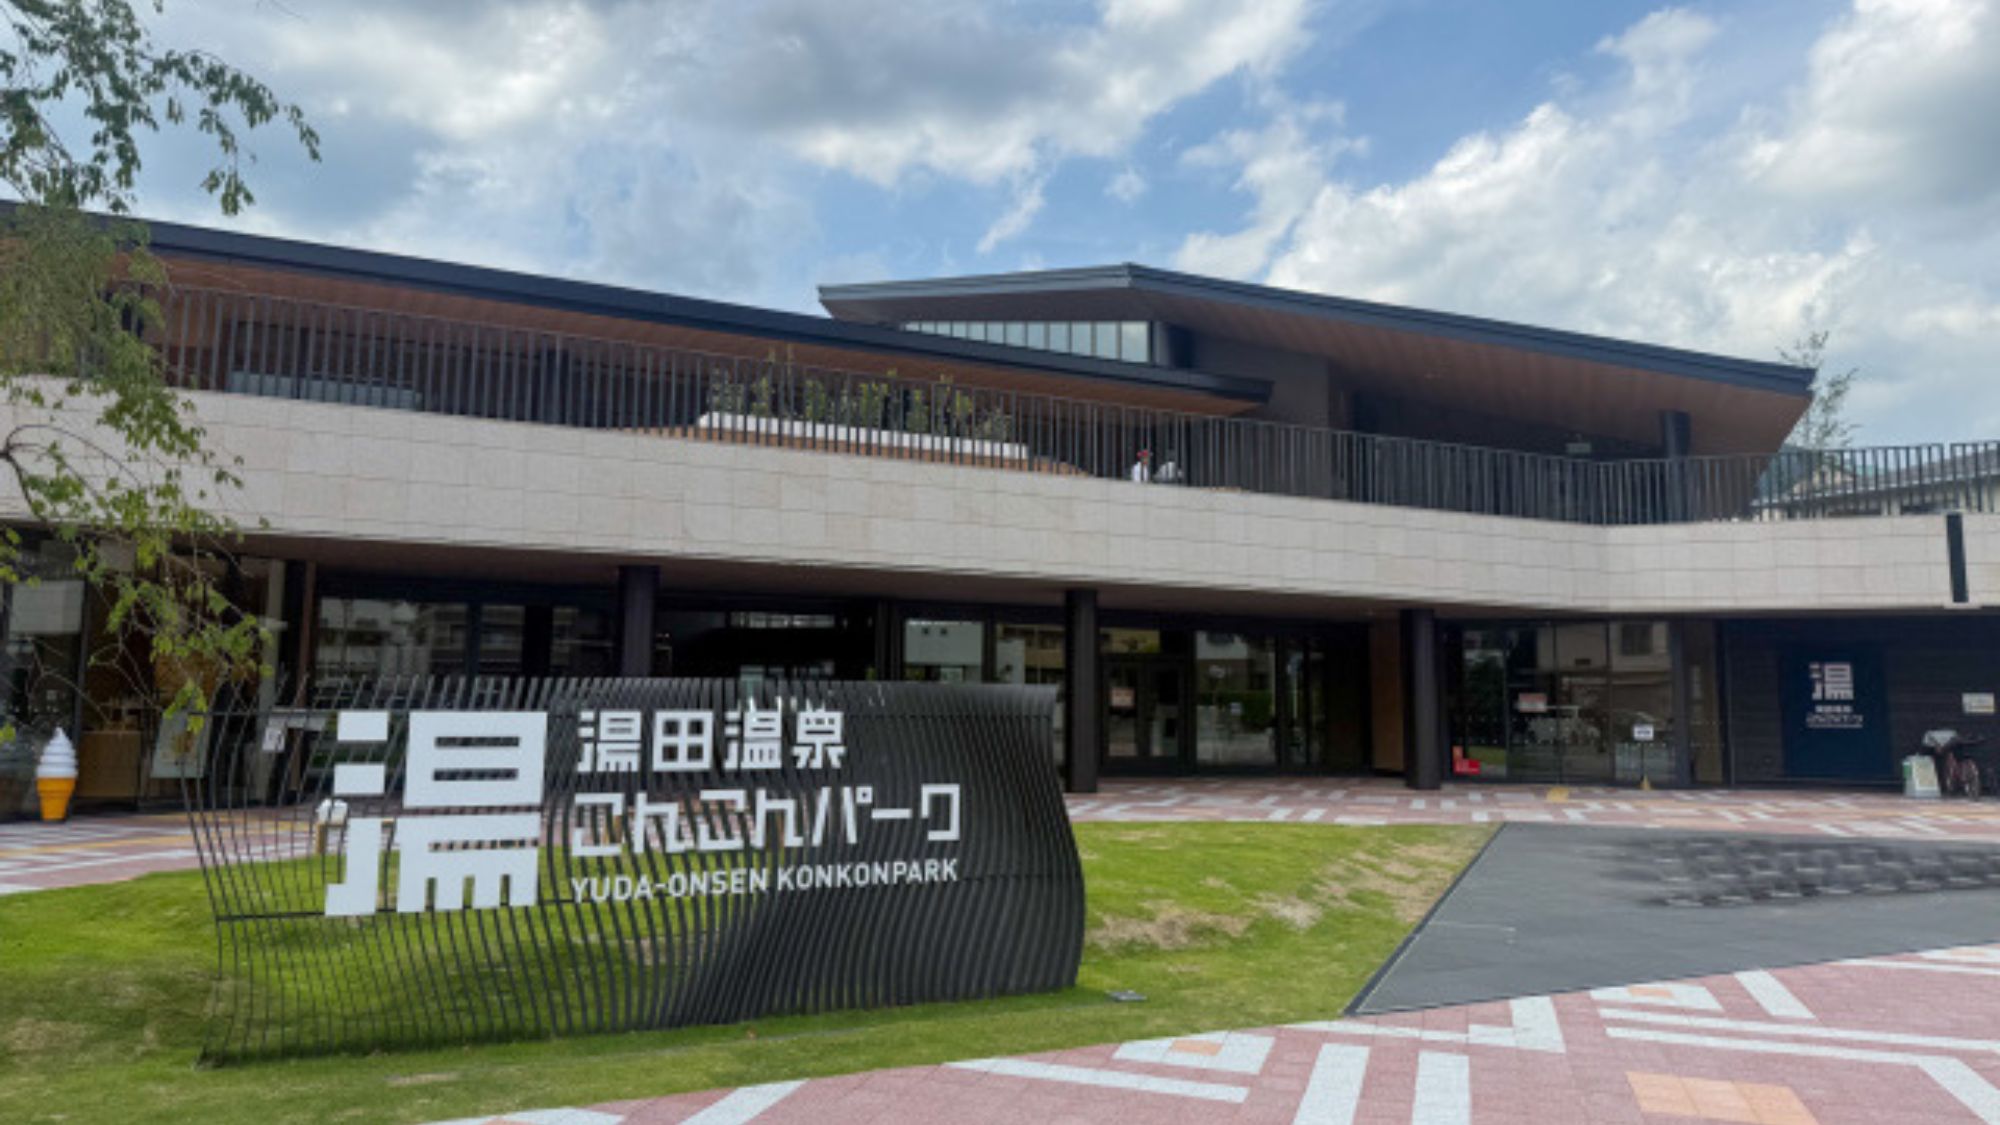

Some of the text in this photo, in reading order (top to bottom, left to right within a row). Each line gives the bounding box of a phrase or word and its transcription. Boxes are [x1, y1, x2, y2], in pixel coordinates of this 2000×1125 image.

[577, 711, 845, 772] 湯田温泉
[325, 711, 547, 917] 湯
[571, 783, 960, 857] こんこんパーク
[571, 858, 958, 902] YUDA-ONSEN KONKONPARK
